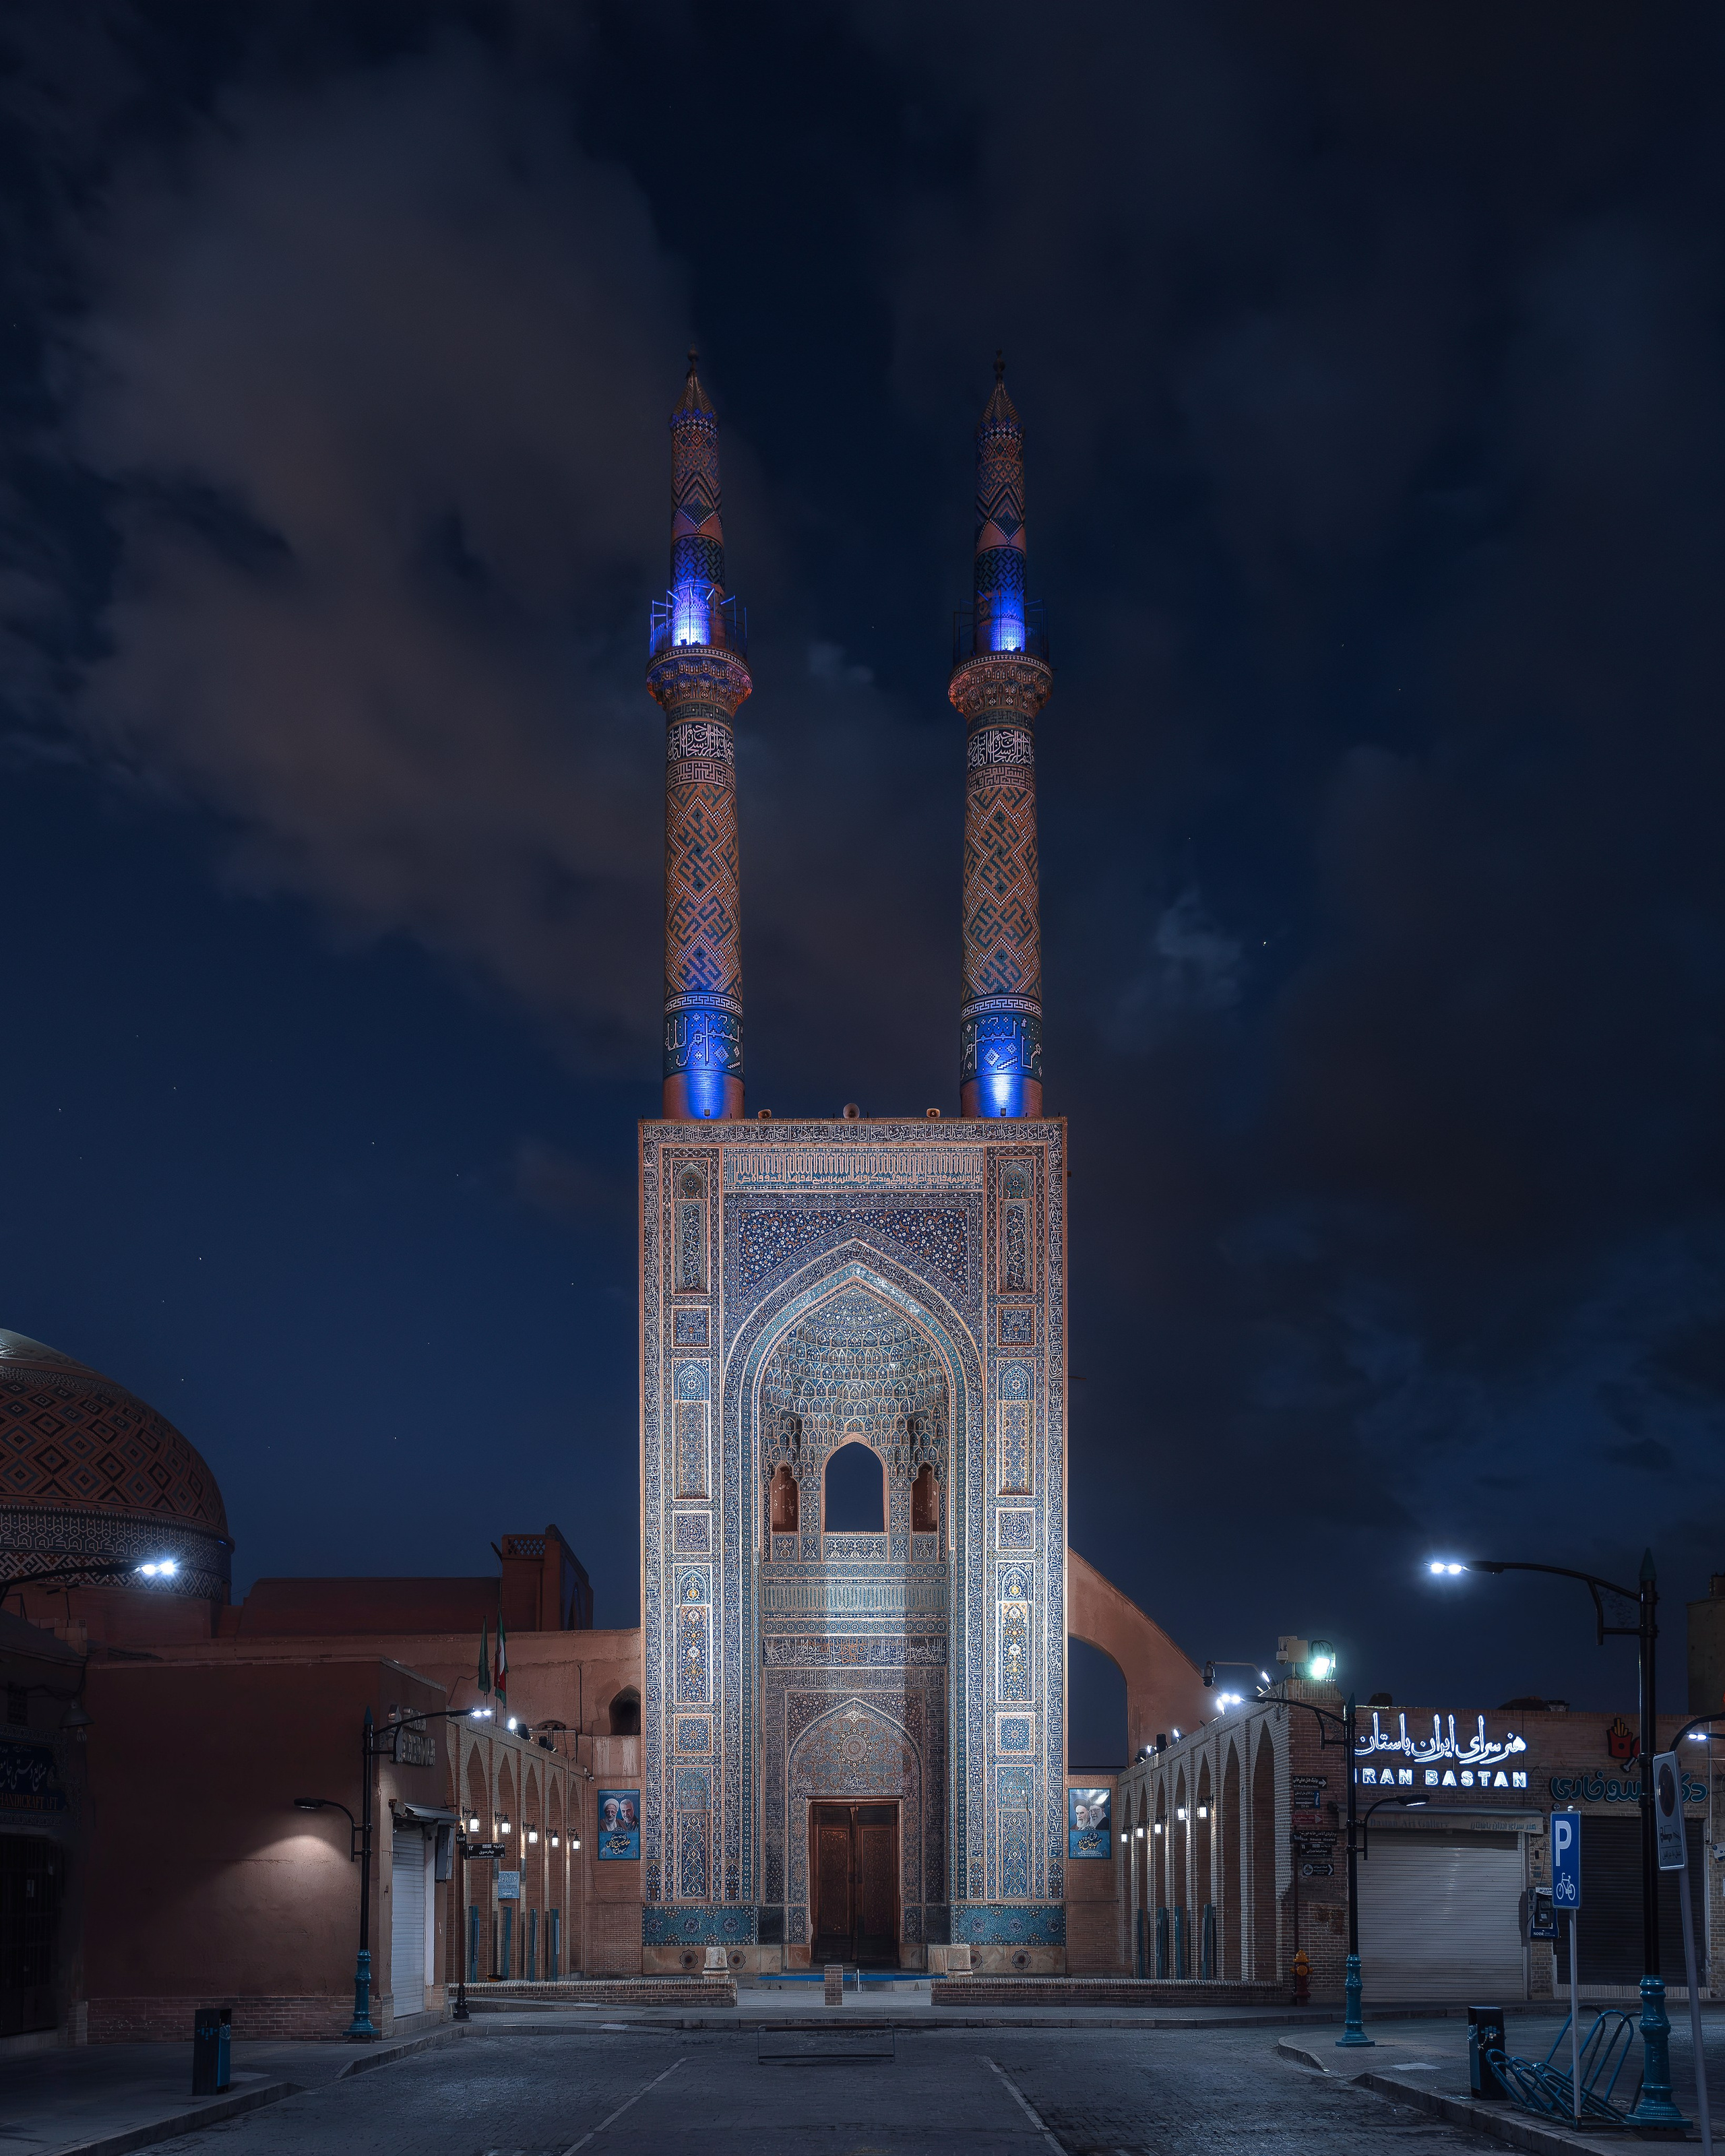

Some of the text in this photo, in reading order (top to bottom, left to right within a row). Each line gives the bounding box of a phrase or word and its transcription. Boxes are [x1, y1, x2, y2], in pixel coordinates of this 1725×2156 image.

[1354, 1711, 1411, 1757] باستان
[1411, 1713, 1455, 1763] ایران
[1425, 1769, 1526, 1787] BASTAN
[1551, 1771, 1641, 1802] سوخاری
[1555, 1820, 1572, 1866] P
